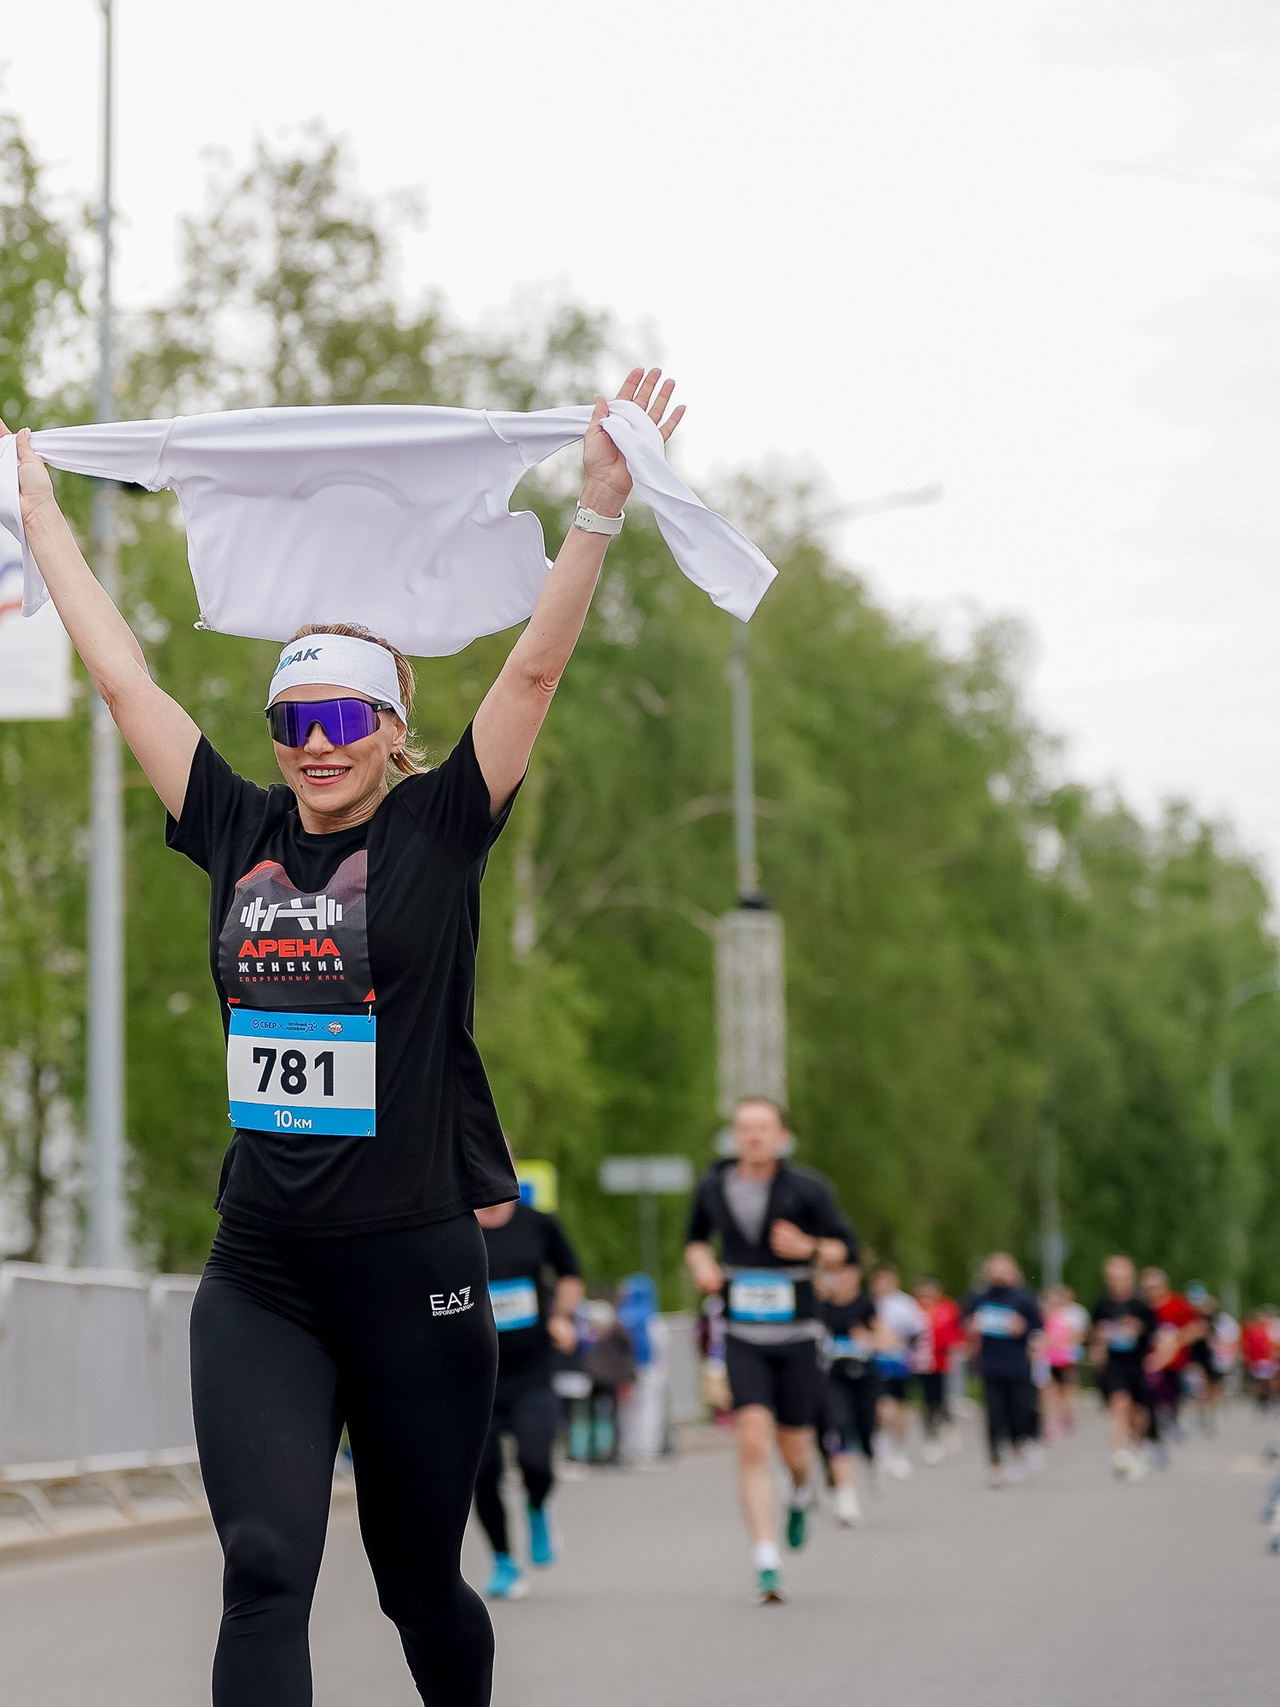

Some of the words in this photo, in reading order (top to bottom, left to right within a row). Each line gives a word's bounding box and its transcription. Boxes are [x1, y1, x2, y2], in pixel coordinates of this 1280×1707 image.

[238, 938, 341, 958] АРЕНА
[238, 958, 344, 973] ЖЕНСКИЙ
[260, 1021, 277, 1029] СБЕР
[252, 1046, 335, 1097] 781
[430, 1286, 471, 1310] EA7
